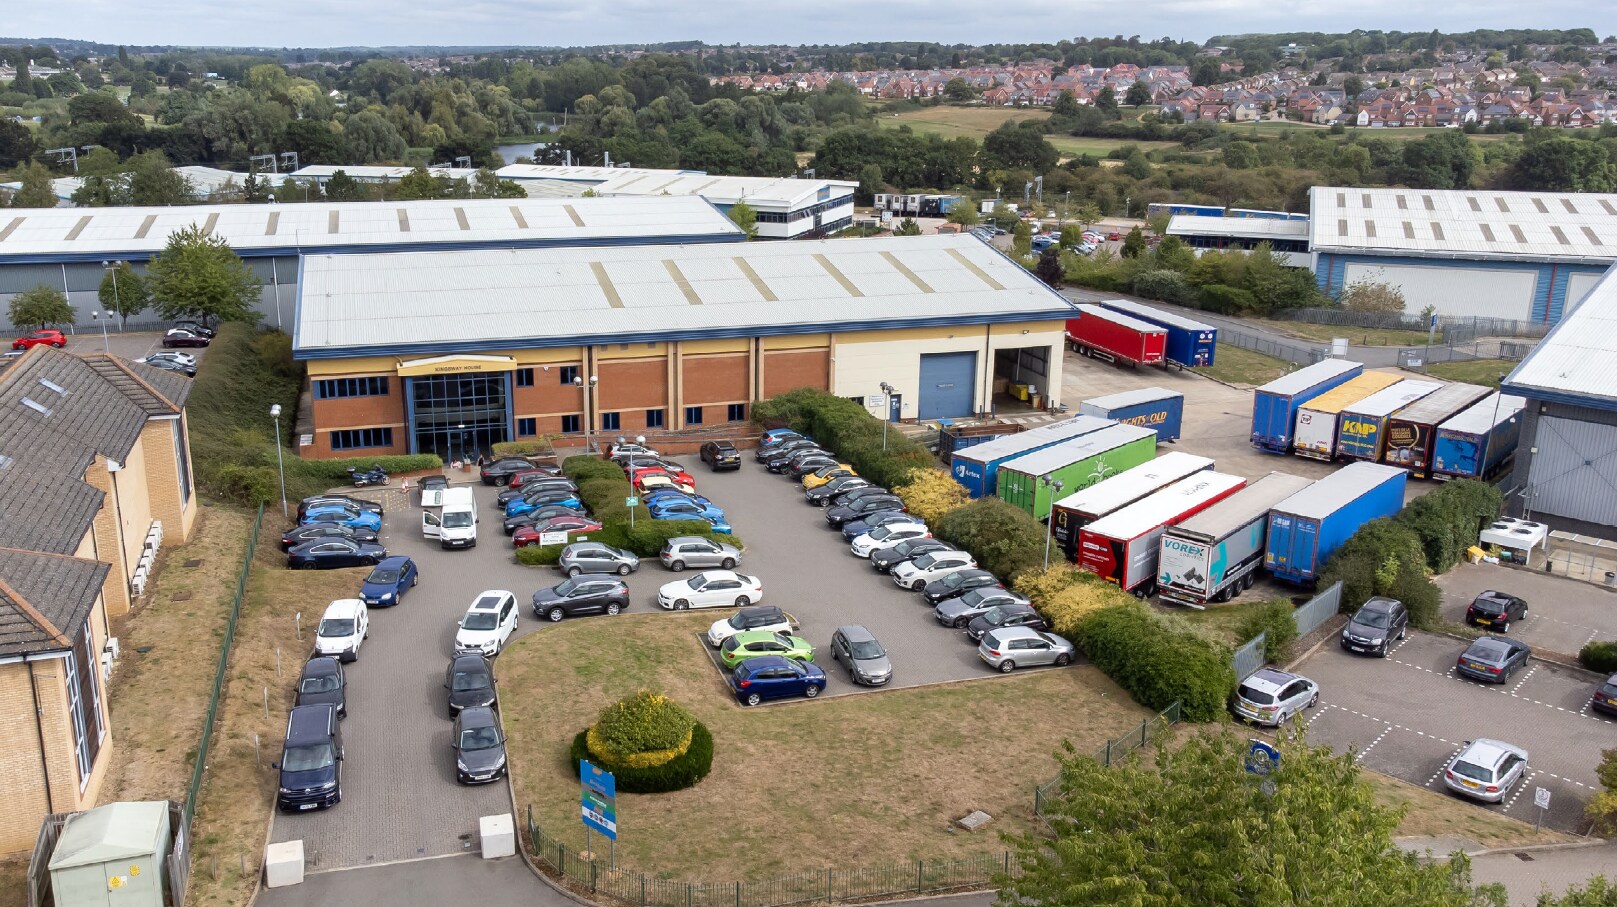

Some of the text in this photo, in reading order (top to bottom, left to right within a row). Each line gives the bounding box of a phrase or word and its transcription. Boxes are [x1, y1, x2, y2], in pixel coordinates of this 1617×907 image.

[1150, 411, 1167, 423] OLD
[1074, 477, 1096, 493] world
[1165, 540, 1204, 556] VOREX
